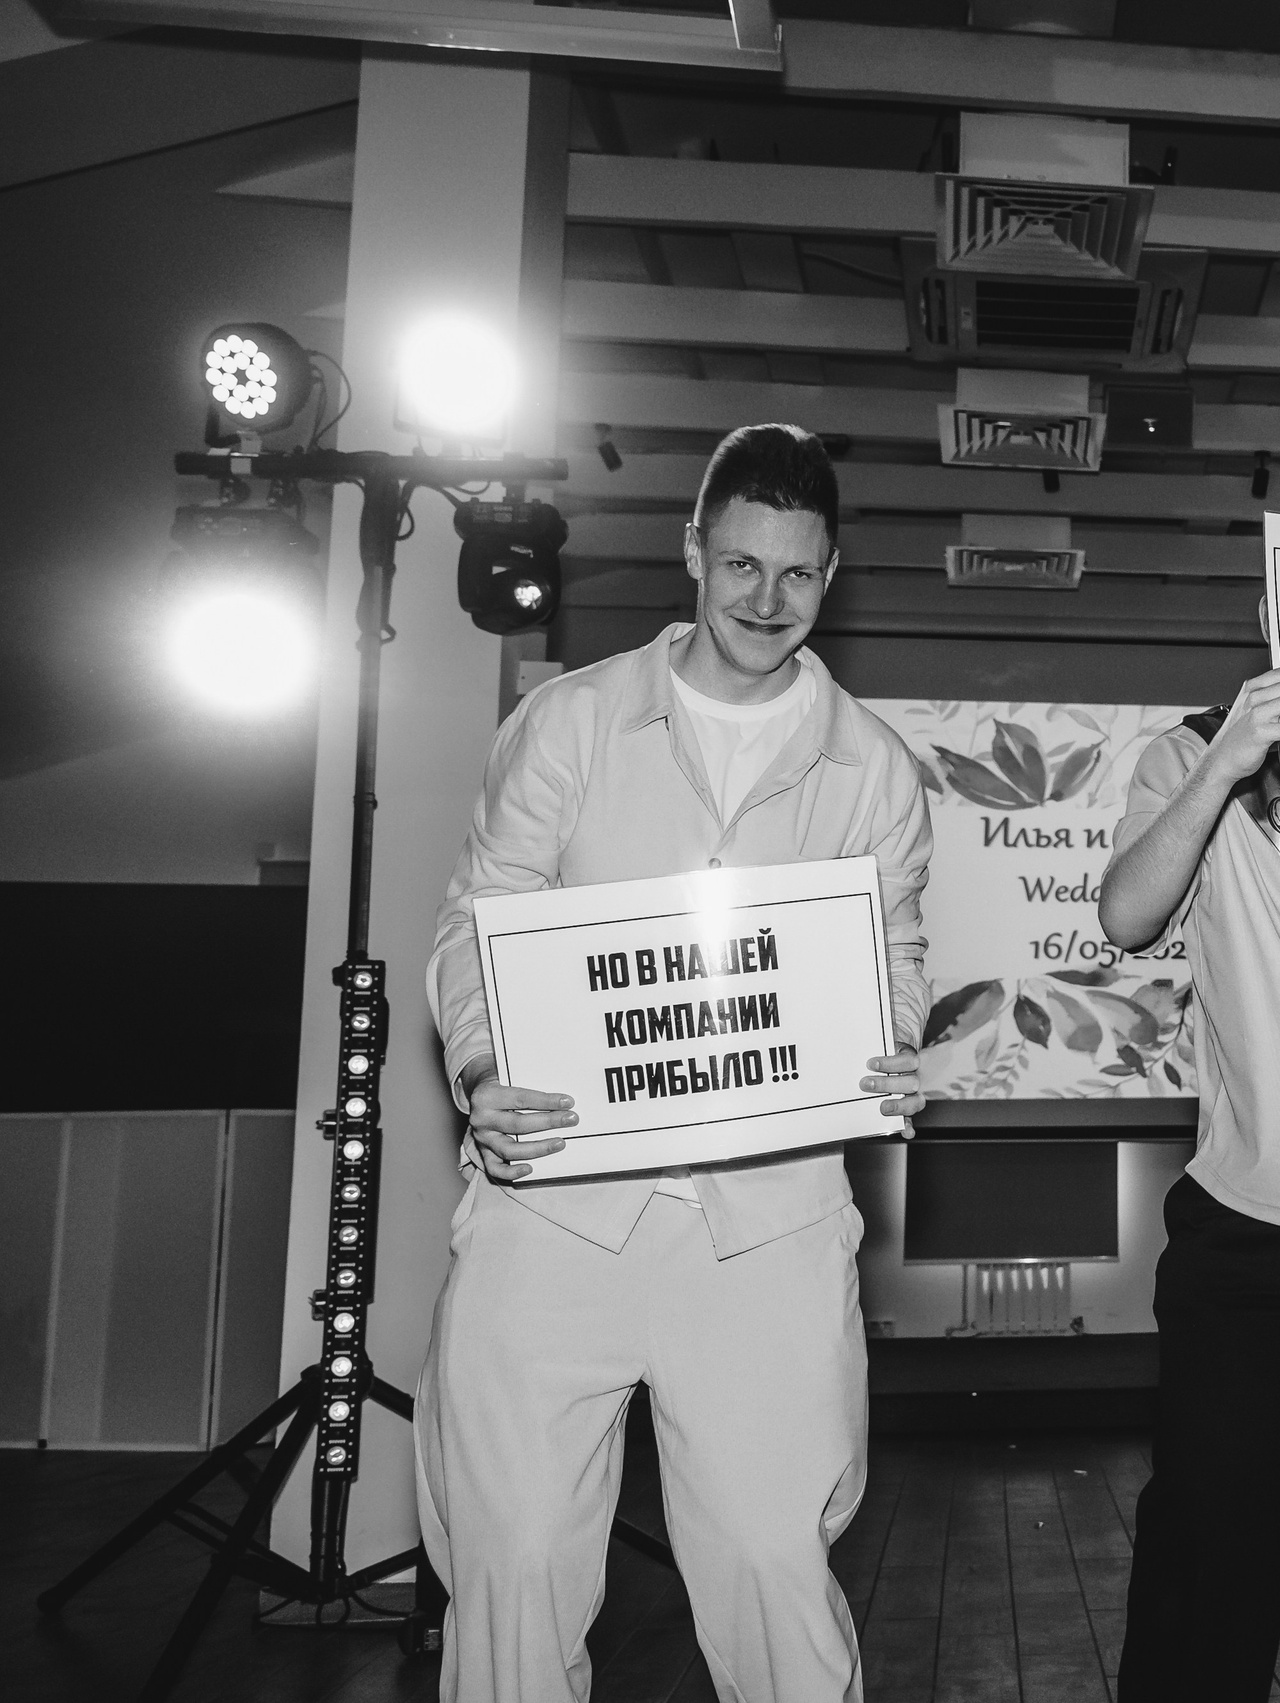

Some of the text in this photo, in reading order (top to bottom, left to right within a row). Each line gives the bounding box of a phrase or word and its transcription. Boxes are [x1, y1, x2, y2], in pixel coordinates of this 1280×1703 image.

[980, 816, 1110, 849] Илья и
[586, 927, 779, 992] НО В НАШЕЙ
[604, 991, 781, 1049] КОМПАНИИ
[604, 1049, 765, 1104] ПРИБЫЛО
